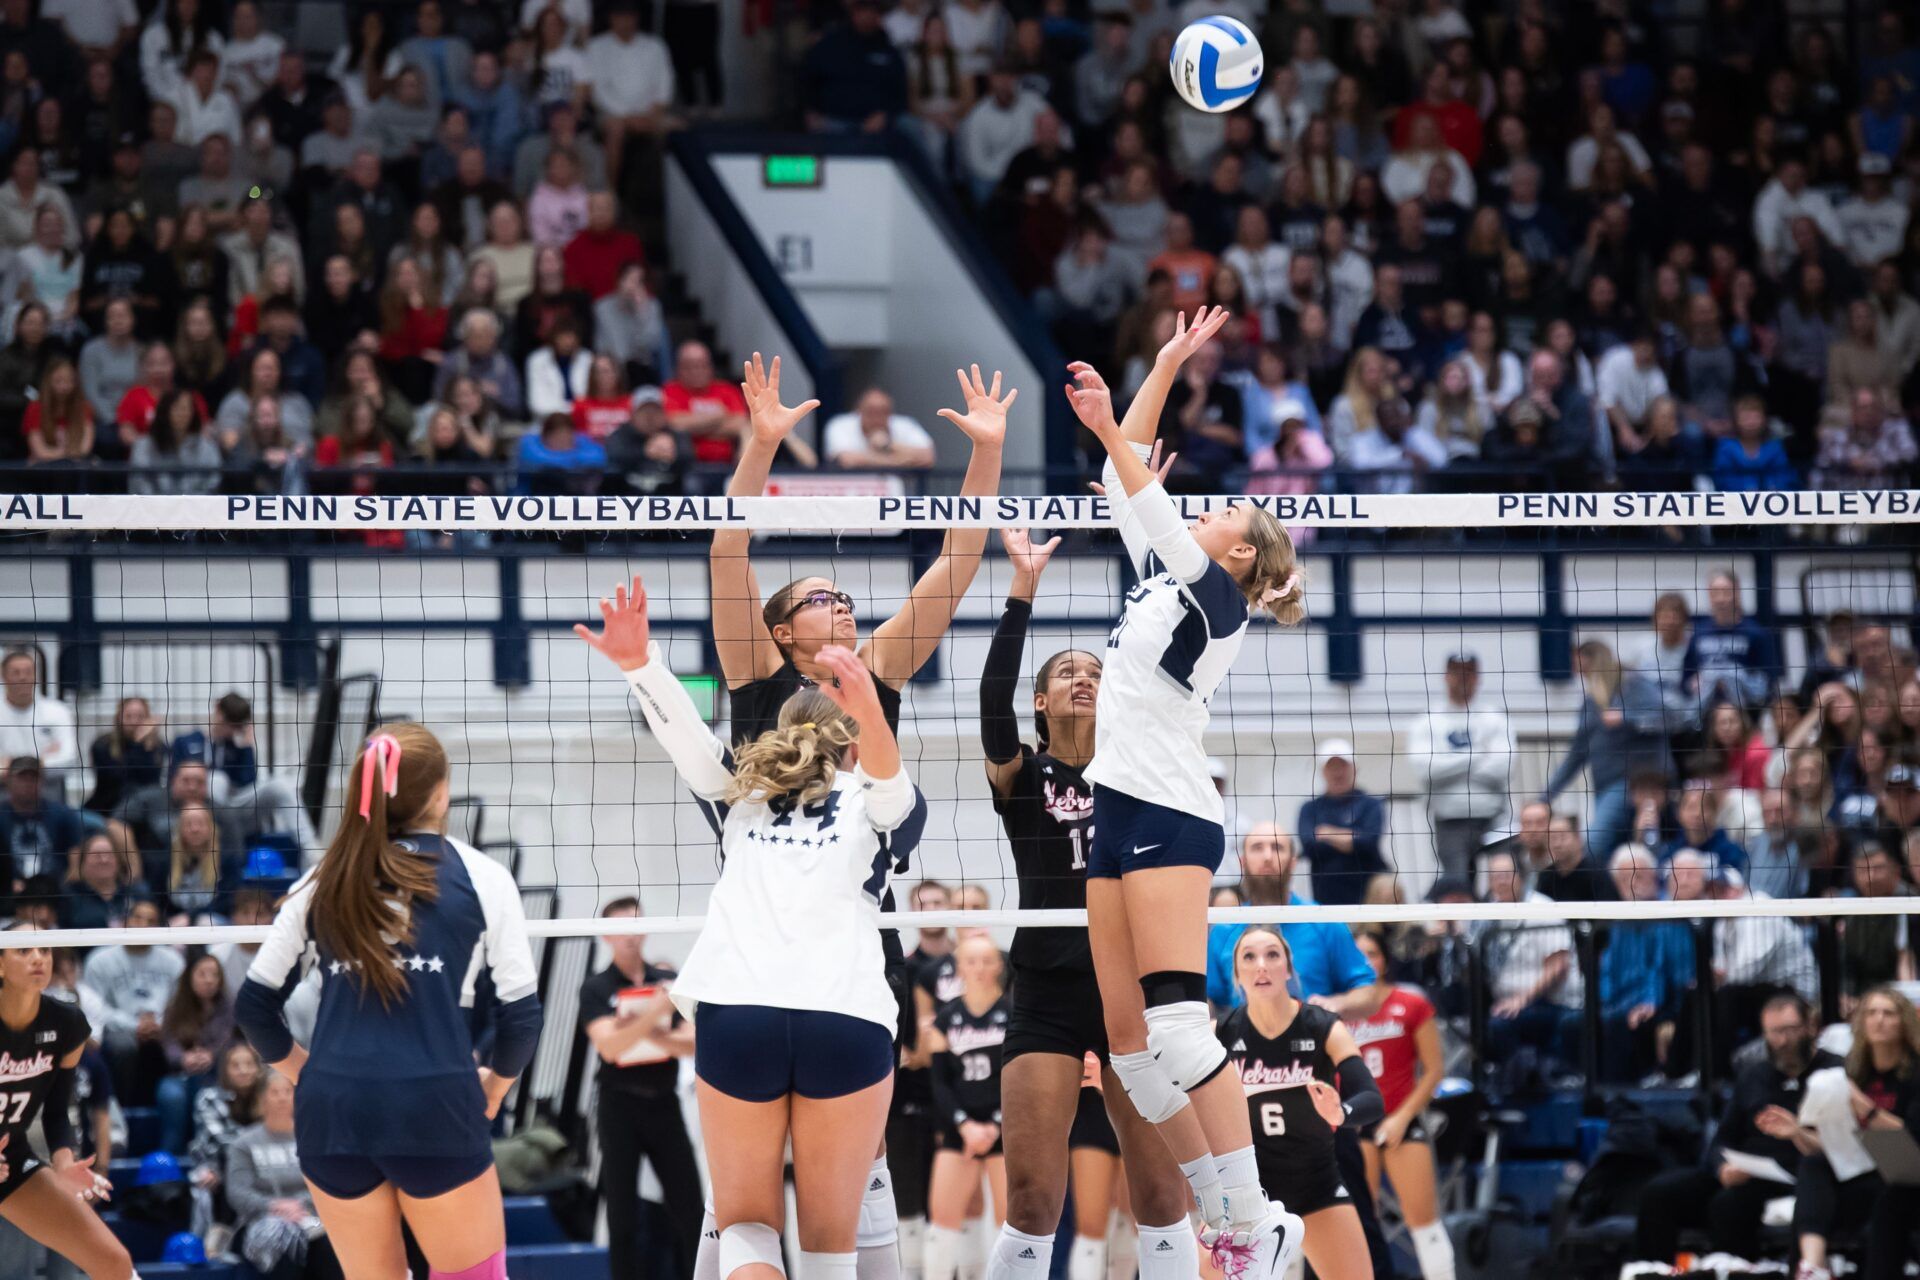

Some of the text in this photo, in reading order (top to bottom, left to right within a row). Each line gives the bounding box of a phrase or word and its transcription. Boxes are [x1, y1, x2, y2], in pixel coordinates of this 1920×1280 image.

[0, 495, 83, 519] ALL
[228, 496, 746, 522] PENN STATE VOLLEYBALL
[879, 496, 981, 521] PENN
[997, 496, 1111, 521] STATE
[1498, 491, 1920, 518] PENN STATE VOLLEYB
[1260, 1102, 1285, 1136] 6
